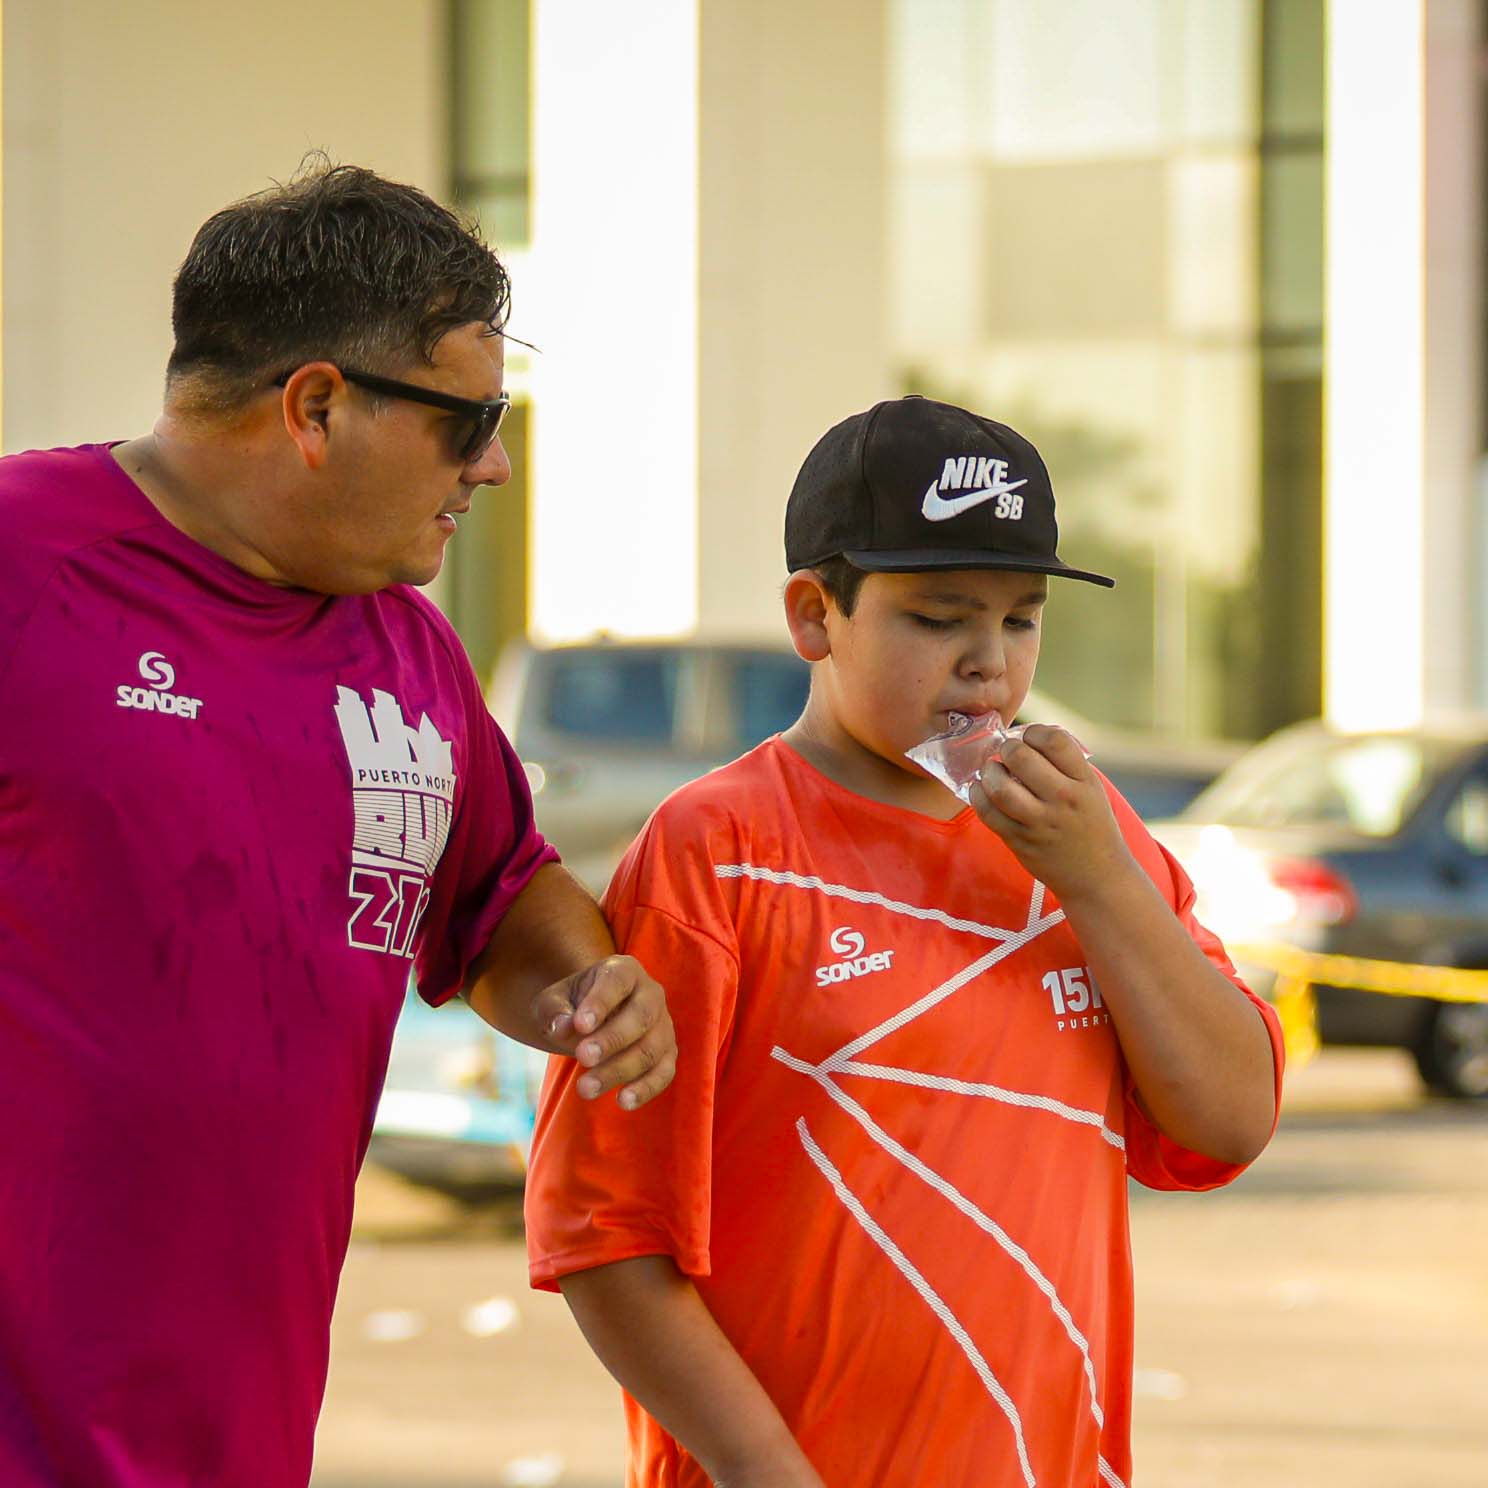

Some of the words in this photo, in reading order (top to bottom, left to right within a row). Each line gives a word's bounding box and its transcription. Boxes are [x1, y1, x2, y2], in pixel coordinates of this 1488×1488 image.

[938, 456, 1009, 489] NIKE
[994, 492, 1024, 520] SB
[358, 769, 420, 786] PUERTO
[425, 775, 454, 796] NORT
[348, 866, 431, 960] 21
[1057, 1014, 1109, 1032] PUERT
